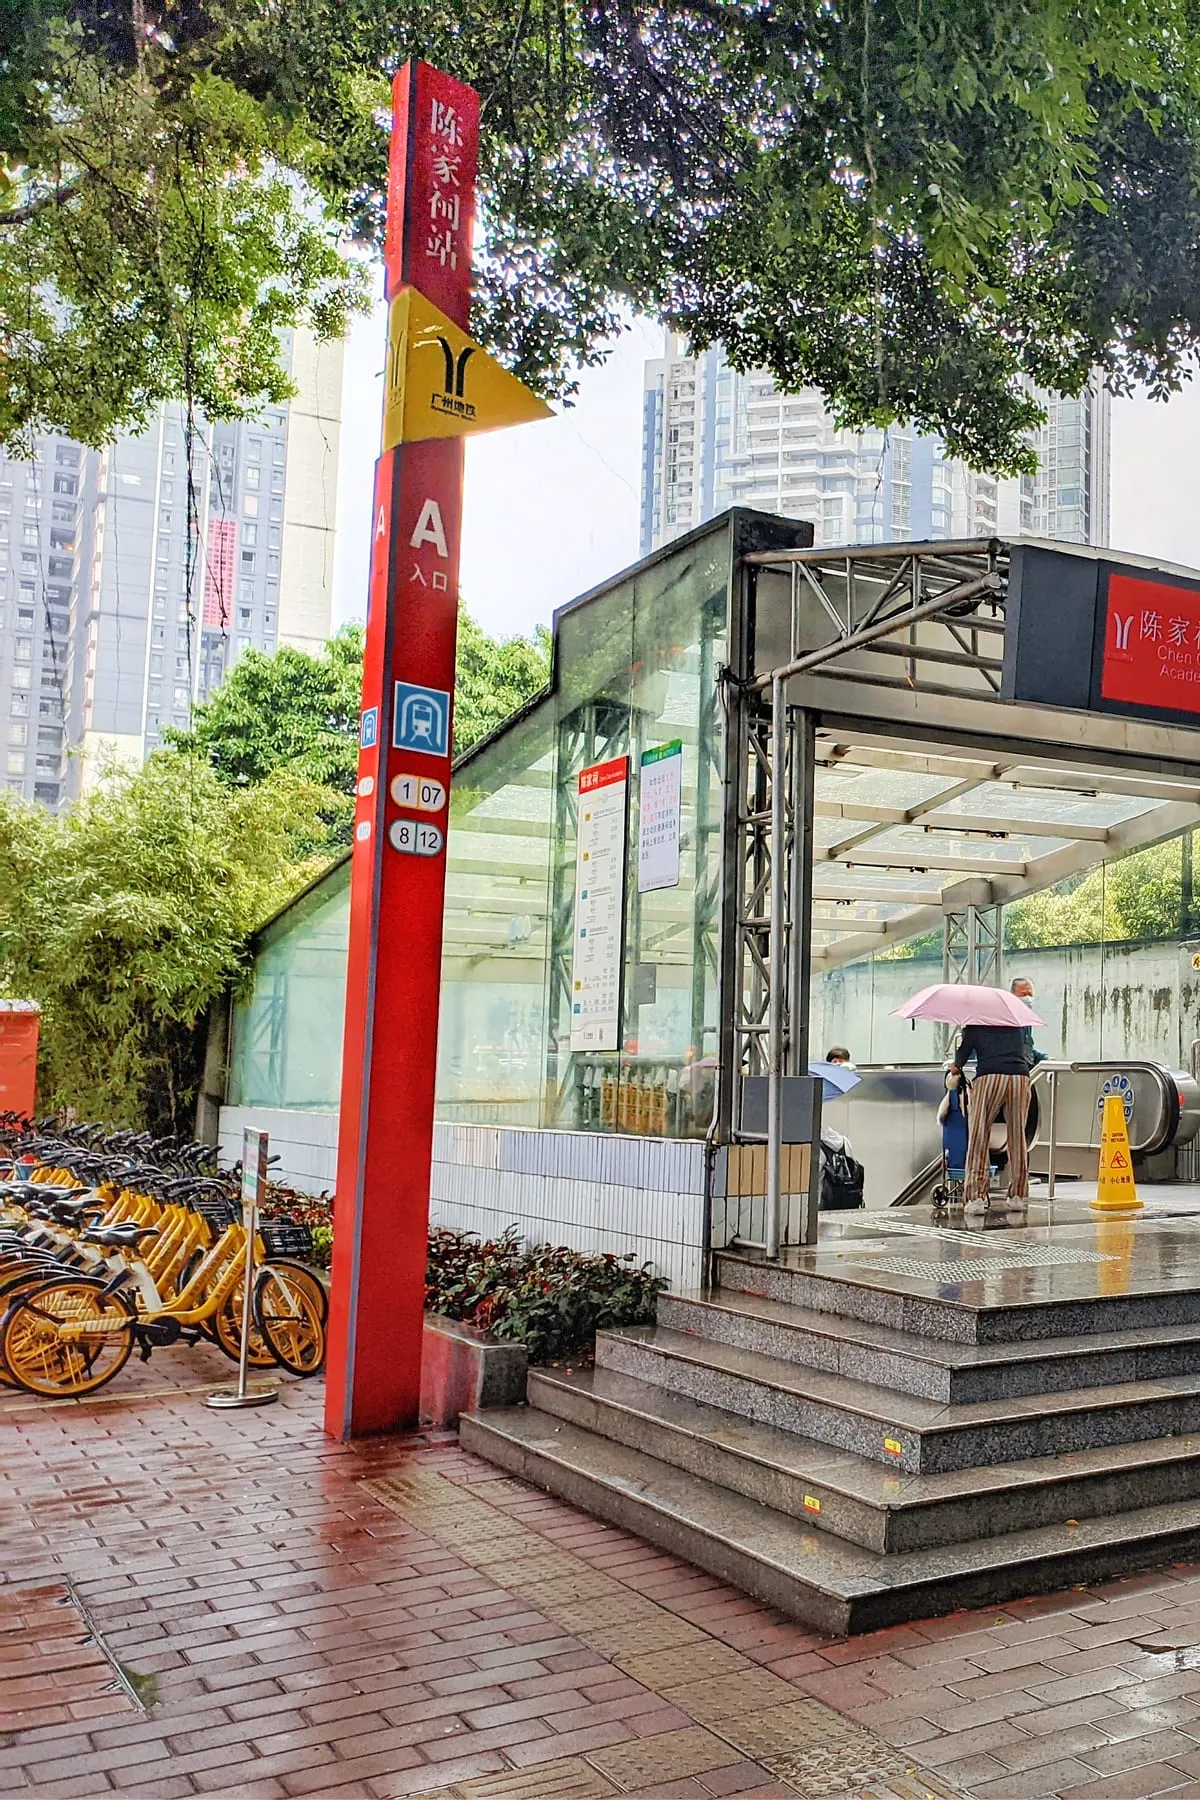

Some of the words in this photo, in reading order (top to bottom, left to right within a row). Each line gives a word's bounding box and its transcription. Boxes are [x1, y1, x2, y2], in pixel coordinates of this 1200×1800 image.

[425, 97, 464, 271] 陈家祠站
[375, 503, 386, 541] A
[409, 498, 449, 558] A
[410, 563, 448, 592] 入口
[1157, 644, 1192, 663] Chen
[402, 782, 410, 800] 1
[421, 785, 441, 804] 07
[399, 827, 409, 845] 8
[420, 831, 438, 849] 12
